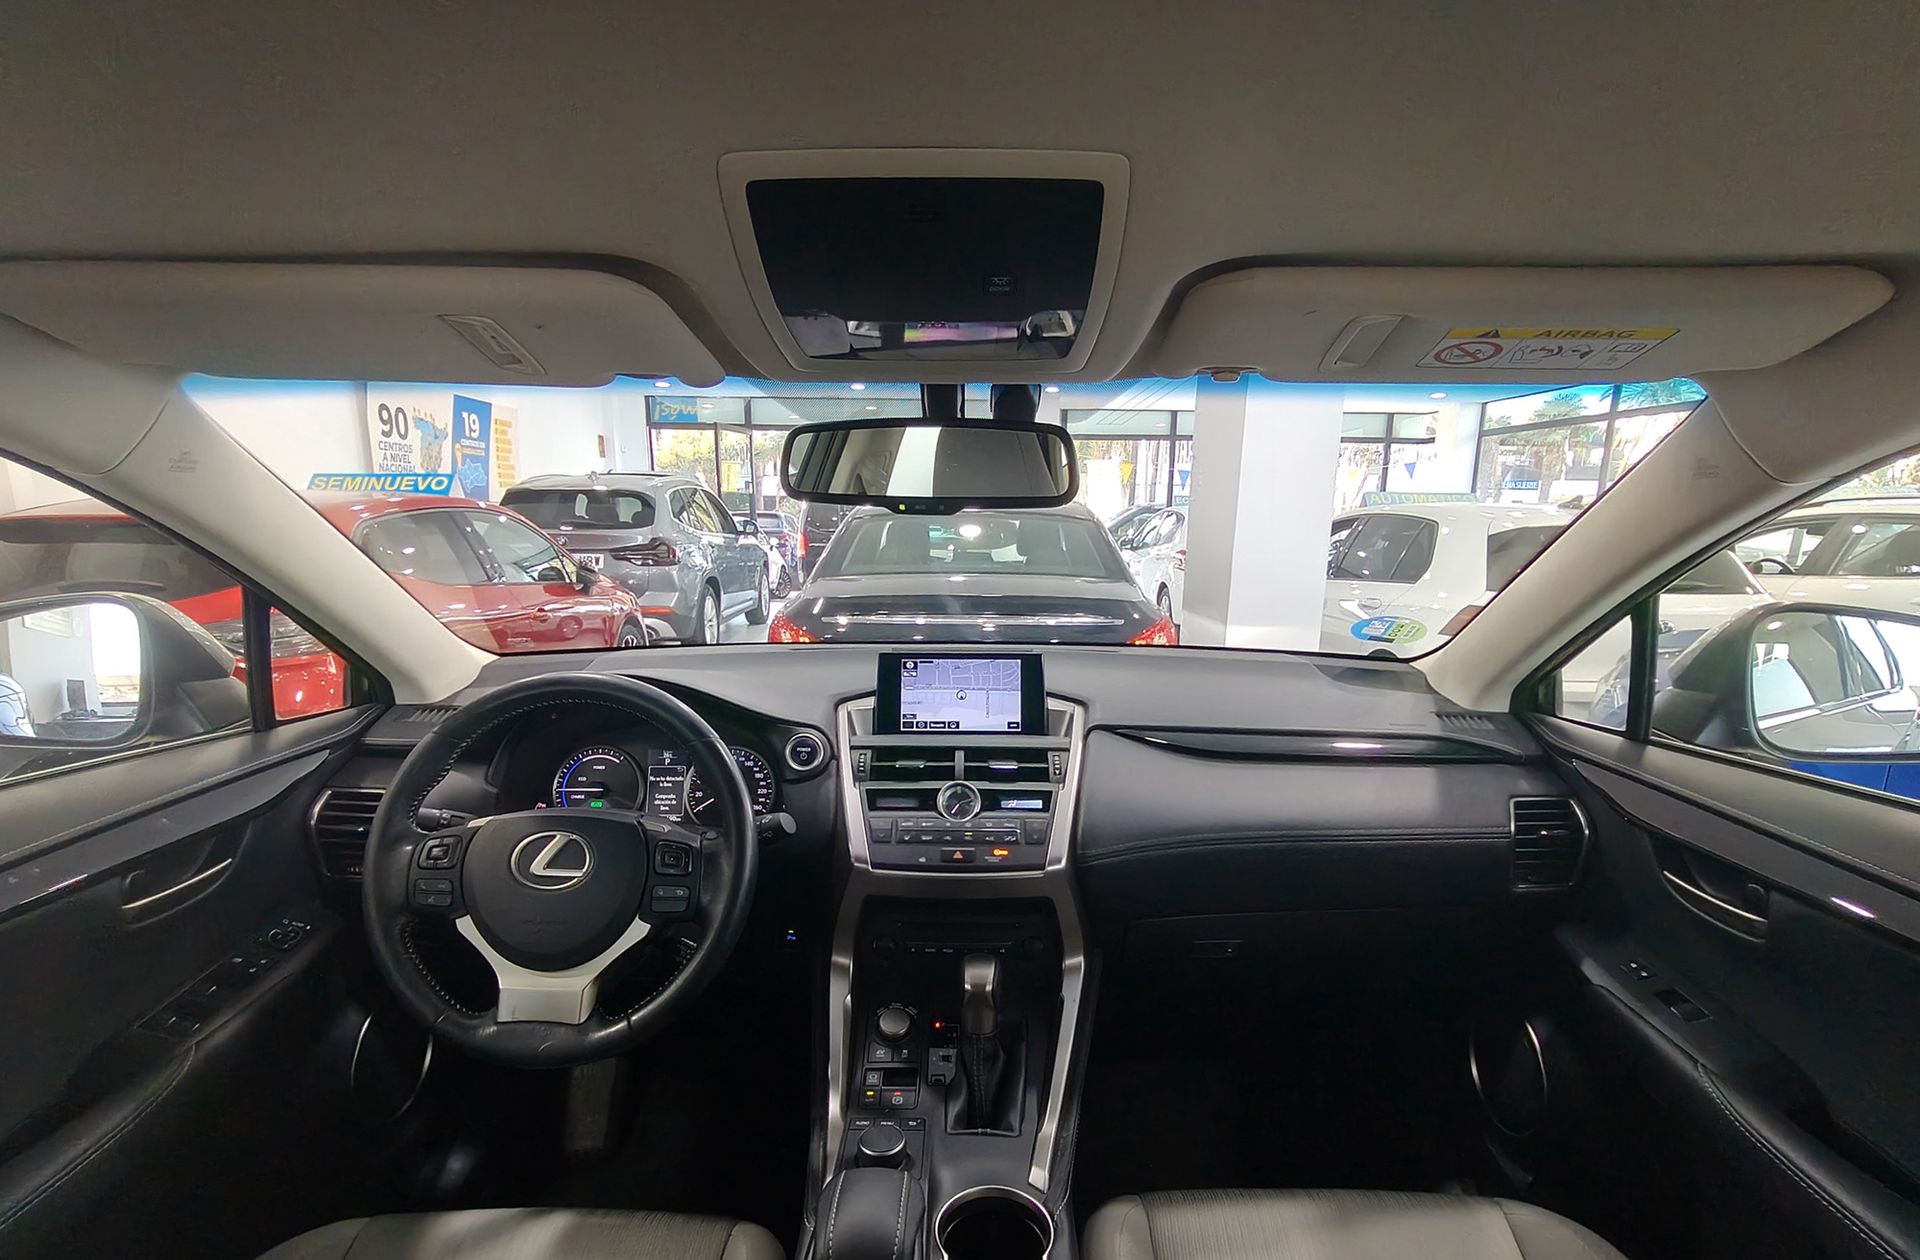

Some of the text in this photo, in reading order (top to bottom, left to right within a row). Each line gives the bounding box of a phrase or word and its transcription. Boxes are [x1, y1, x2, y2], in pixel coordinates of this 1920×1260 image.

[1533, 329, 1638, 339] AIRBAG
[378, 403, 409, 440] 90
[461, 411, 480, 438] 19
[378, 440, 413, 454] CENTROS
[382, 451, 411, 464] A NIVEL
[378, 463, 416, 473] NACIONAL
[311, 476, 448, 491] SEMINUEVO
[665, 758, 671, 766] P
